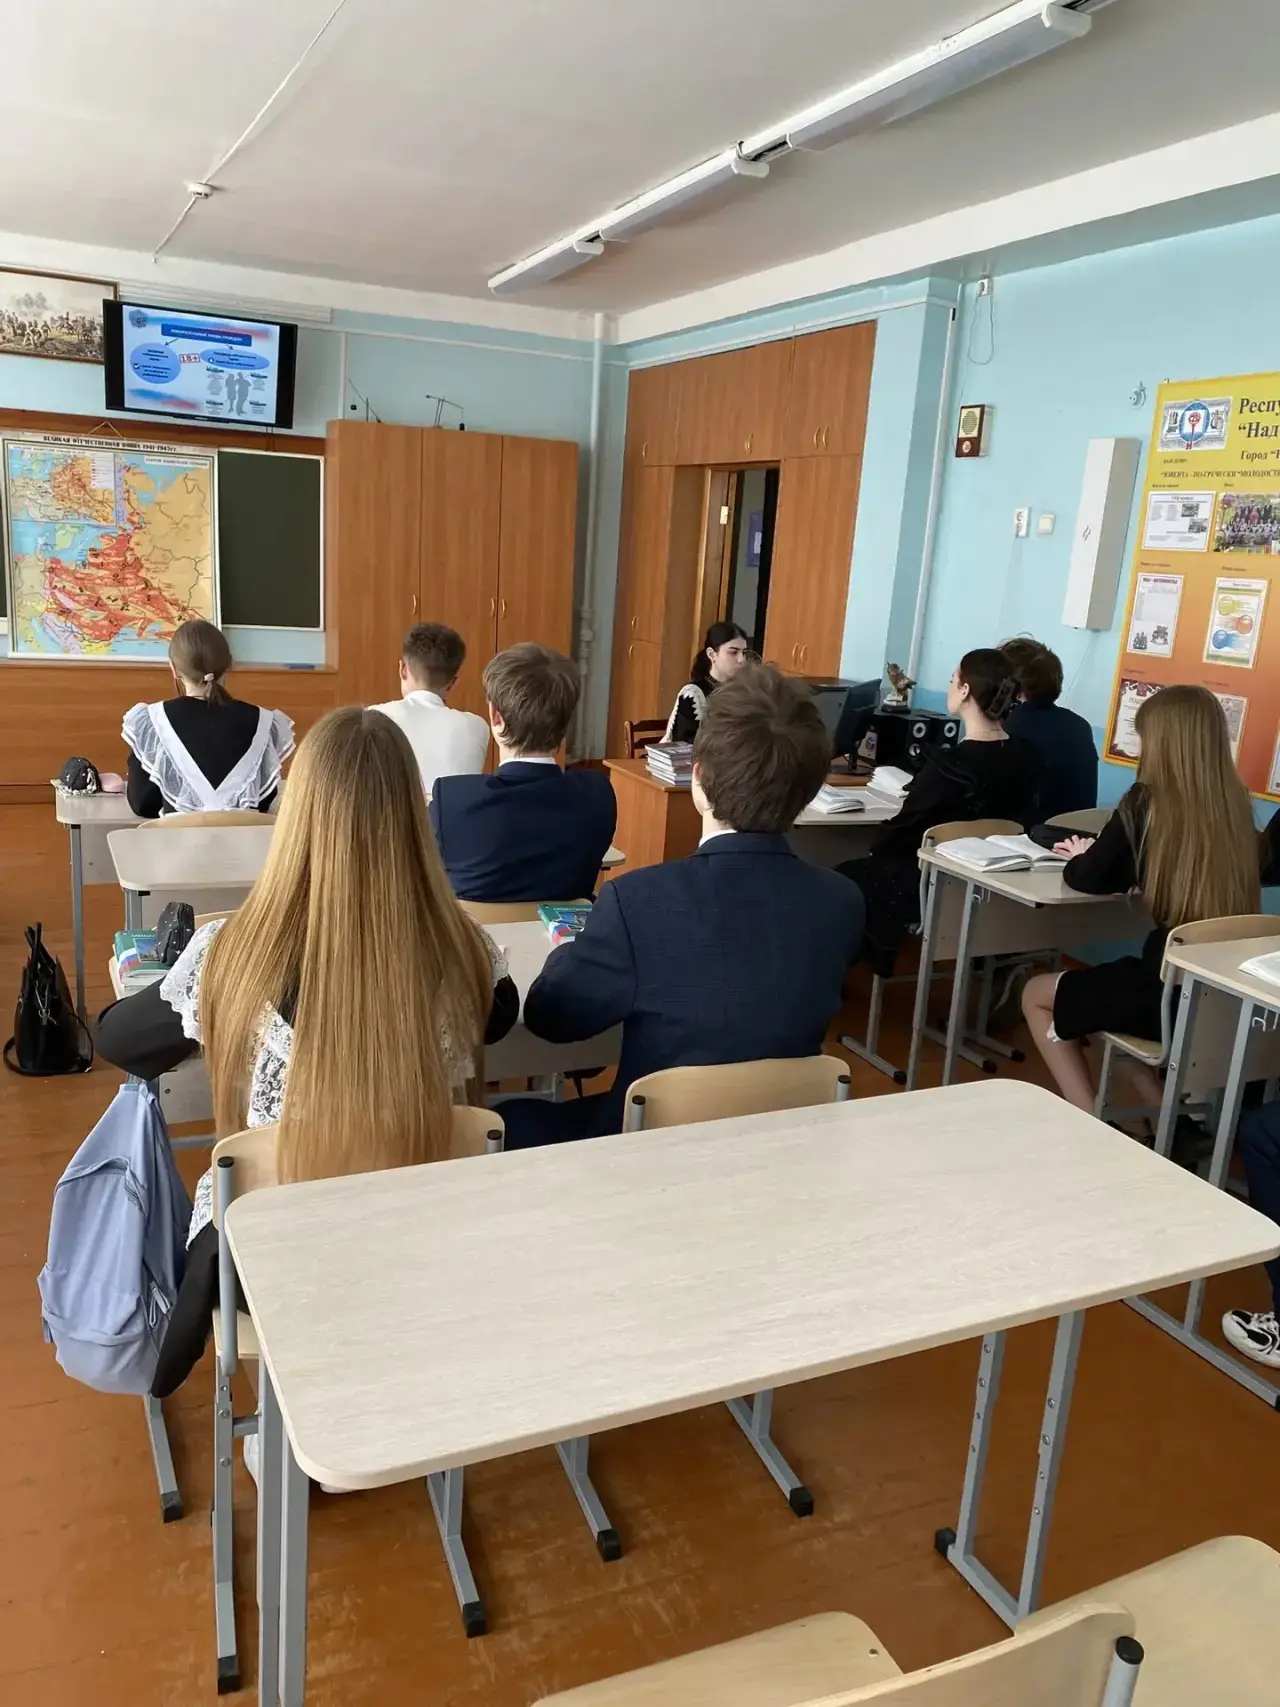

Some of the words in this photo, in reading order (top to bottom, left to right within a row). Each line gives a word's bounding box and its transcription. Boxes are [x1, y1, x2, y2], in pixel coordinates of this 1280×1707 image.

[181, 354, 198, 363] 18+
[43, 435, 71, 443] ВЕЛИКАЯ
[72, 438, 120, 447] ОТЕЧЕСТВЕННАЯ
[1240, 450, 1268, 462] Город
